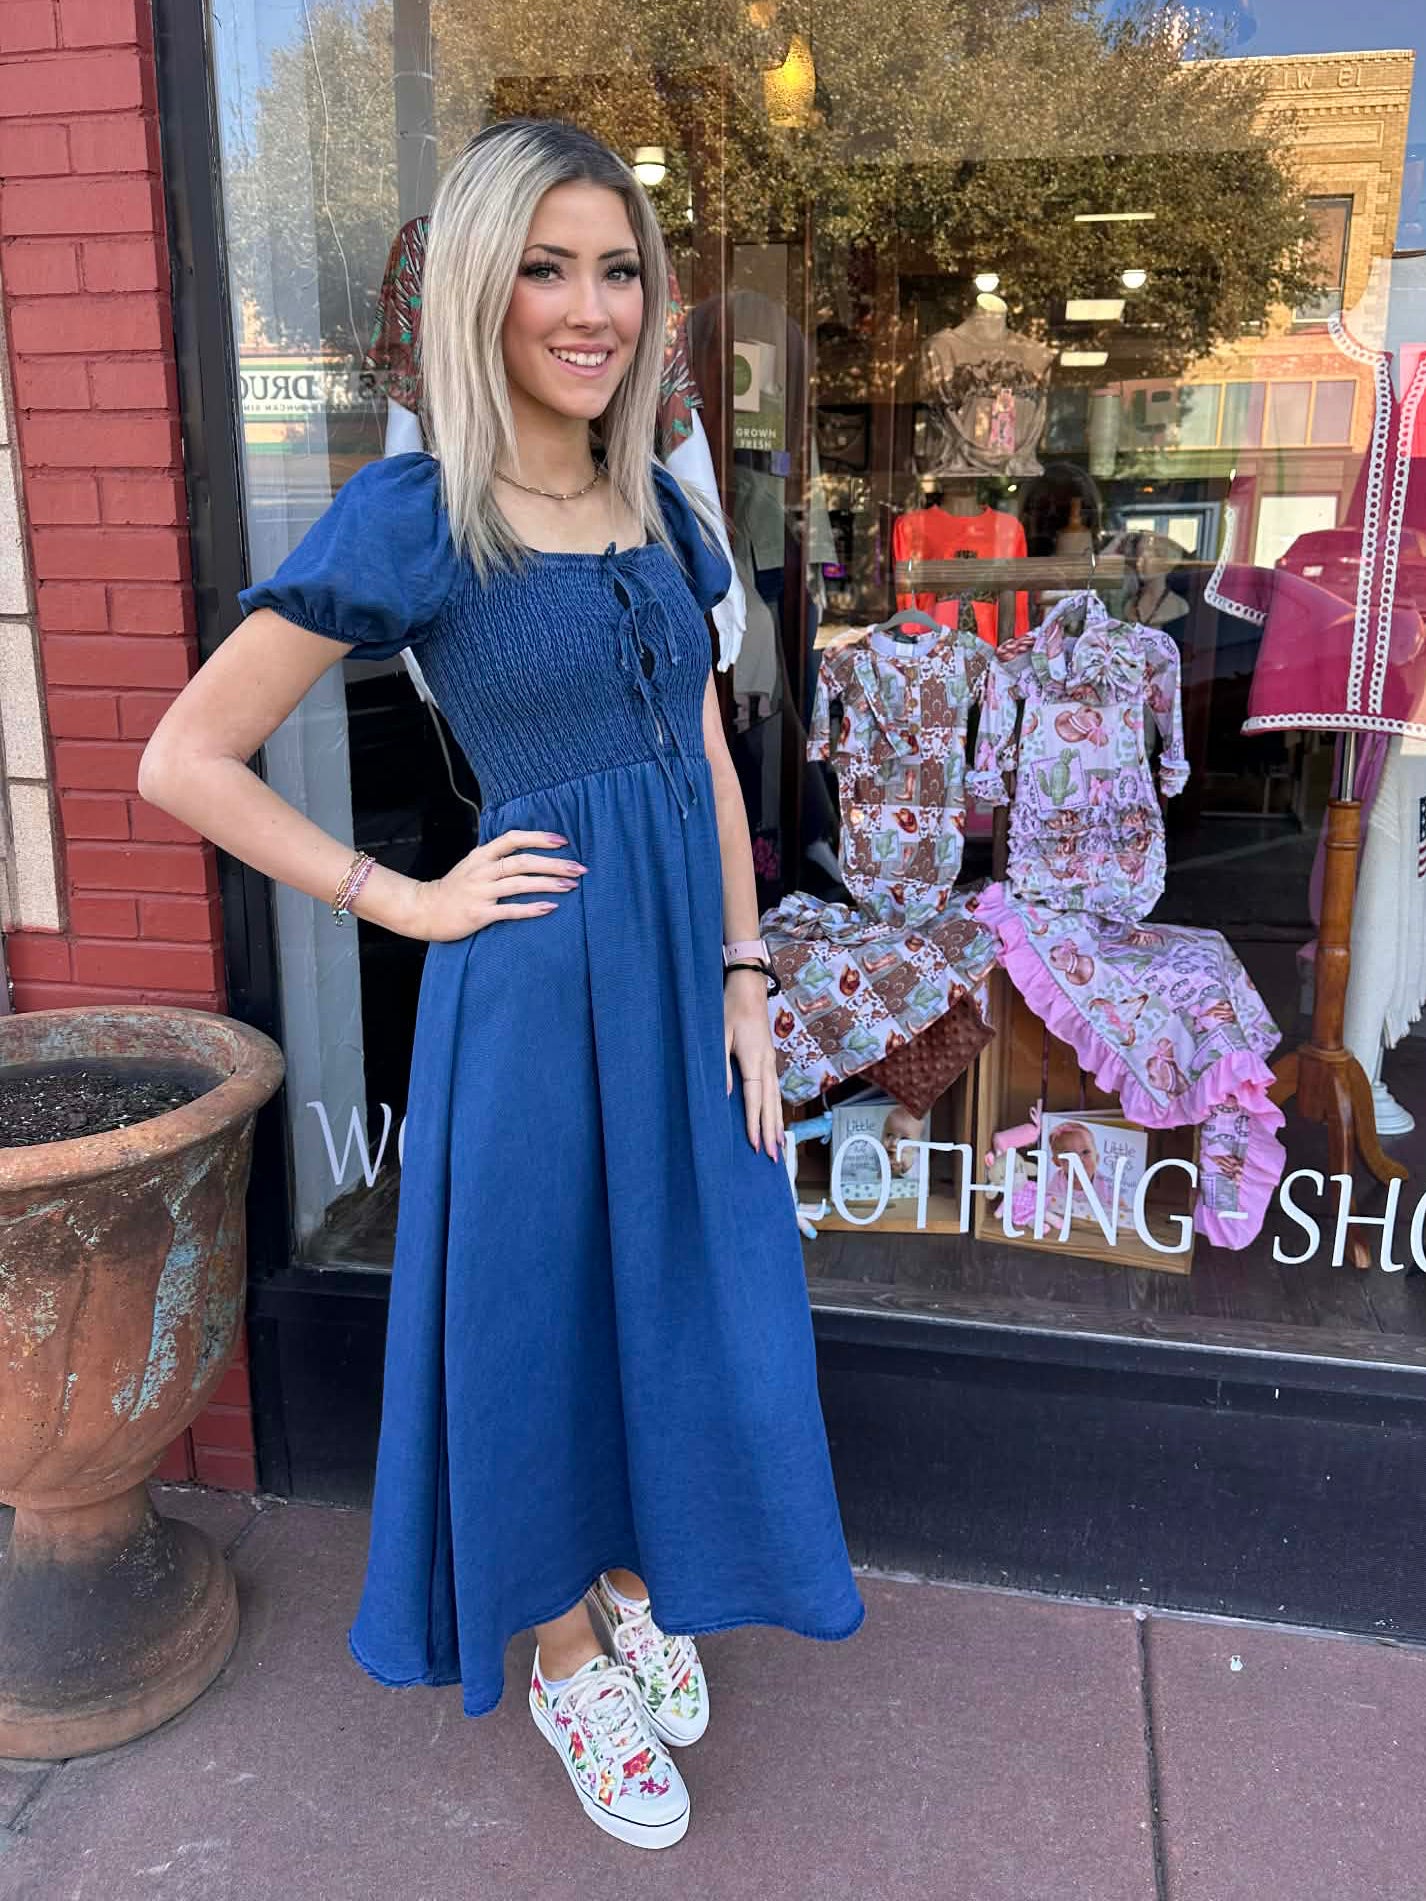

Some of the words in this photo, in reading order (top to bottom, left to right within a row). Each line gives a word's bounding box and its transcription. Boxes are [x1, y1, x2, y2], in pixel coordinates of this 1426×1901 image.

[736, 428, 777, 438] GROWN
[847, 1117, 876, 1133] Little
[1104, 1139, 1137, 1158] Little
